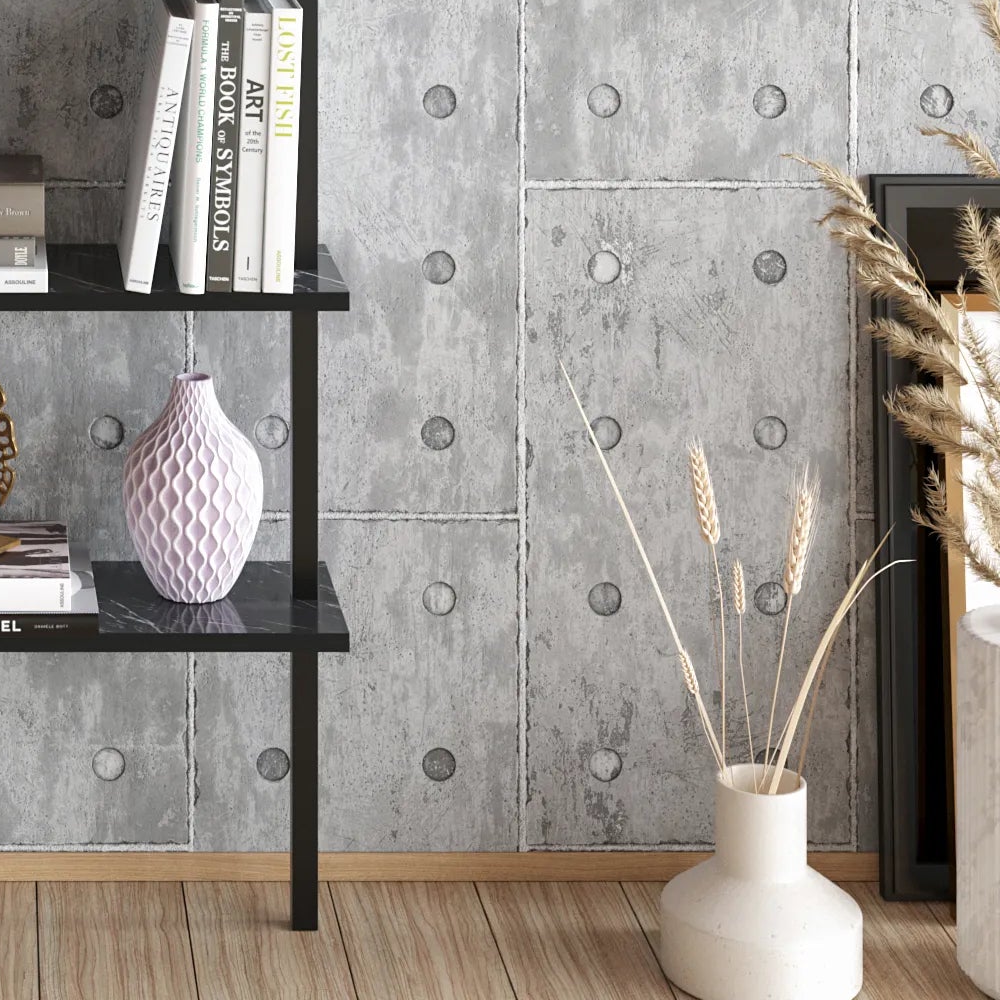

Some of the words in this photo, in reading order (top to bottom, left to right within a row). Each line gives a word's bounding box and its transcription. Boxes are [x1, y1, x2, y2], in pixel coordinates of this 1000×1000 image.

[200, 19, 210, 64] FORMULA
[220, 40, 230, 62] THE
[276, 16, 297, 79] LOST
[217, 66, 237, 126] BOOK
[245, 78, 264, 122] ART
[274, 85, 295, 138] FISH
[146, 87, 180, 222] ANTIQUAIRES
[195, 109, 206, 164] CHAMPIONS
[217, 129, 227, 144] OF
[241, 146, 263, 154] Century
[5, 207, 30, 216] Brown
[212, 148, 234, 252] SYMBOLS
